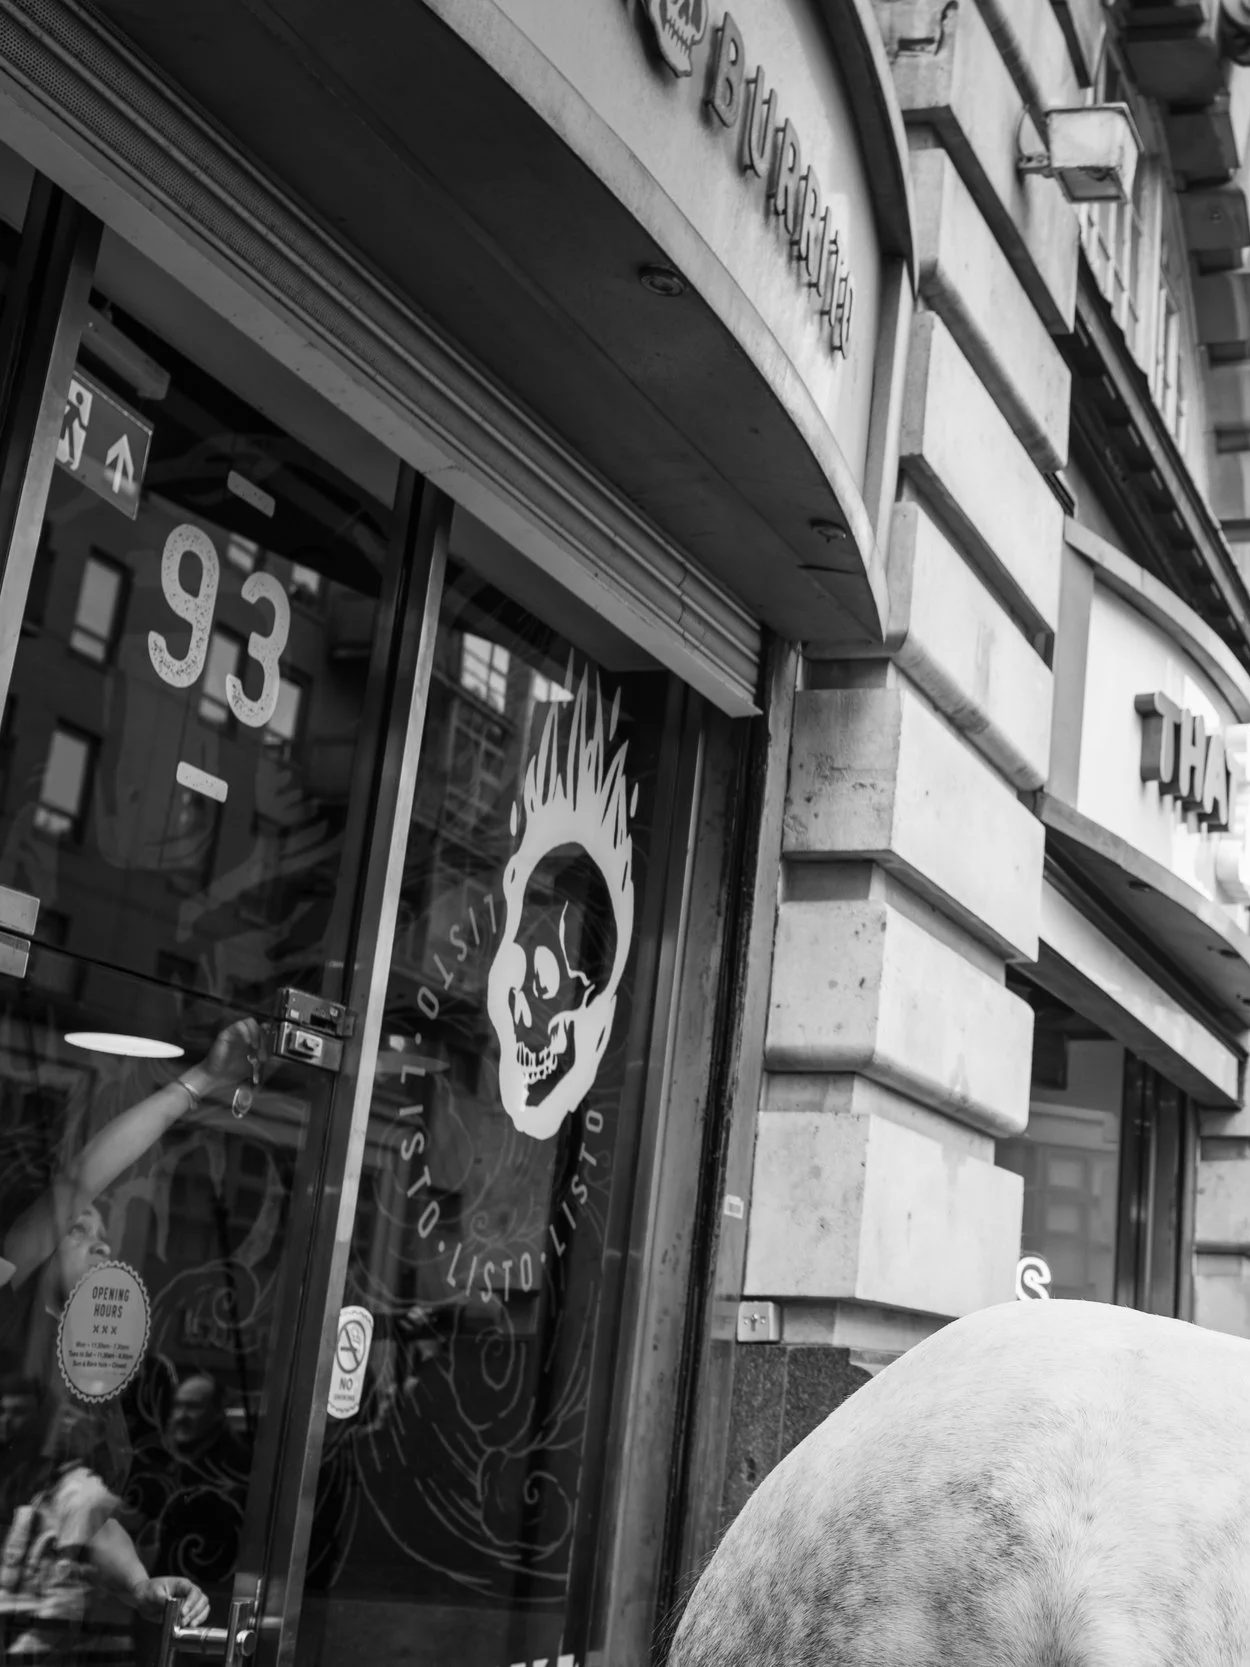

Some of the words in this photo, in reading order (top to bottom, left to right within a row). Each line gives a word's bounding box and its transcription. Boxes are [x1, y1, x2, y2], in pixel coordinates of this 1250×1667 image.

[148, 523, 291, 728] 93
[447, 1242, 533, 1303] LISTO
[92, 1286, 130, 1302] OPENING
[93, 1303, 123, 1318] HOURS
